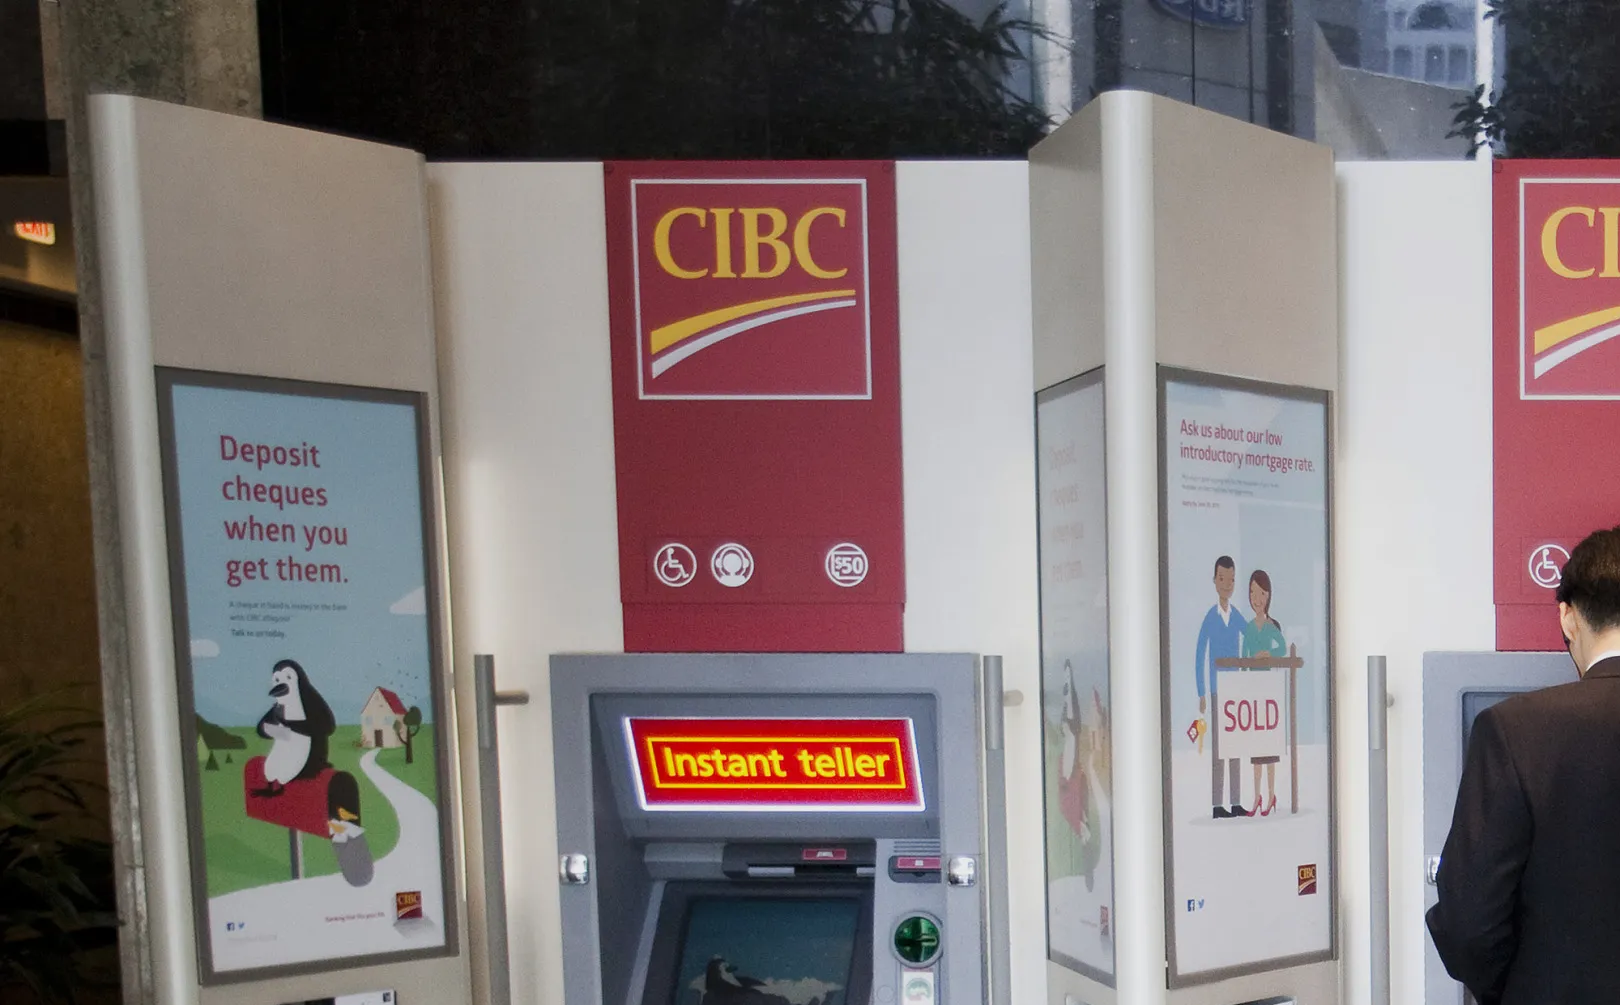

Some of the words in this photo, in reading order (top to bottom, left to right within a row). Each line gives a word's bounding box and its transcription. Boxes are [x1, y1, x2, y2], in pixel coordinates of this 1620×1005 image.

[654, 207, 848, 279] CIBC
[1180, 419, 1201, 437] Ask
[1201, 425, 1212, 438] us
[1214, 424, 1244, 442] about
[1246, 430, 1264, 444] our
[1265, 430, 1283, 446] low
[220, 434, 320, 471] Deposit
[1180, 442, 1243, 469] introductory
[1245, 453, 1293, 473] mortgage
[1295, 459, 1315, 472] rate.
[222, 474, 328, 511] cheques
[224, 514, 296, 543] when
[303, 525, 348, 552] you
[226, 558, 269, 588] get
[276, 555, 348, 583] them.
[835, 556, 863, 575] $50
[1223, 699, 1279, 732] SOLD
[664, 747, 786, 777] Instant
[798, 747, 890, 777] teller
